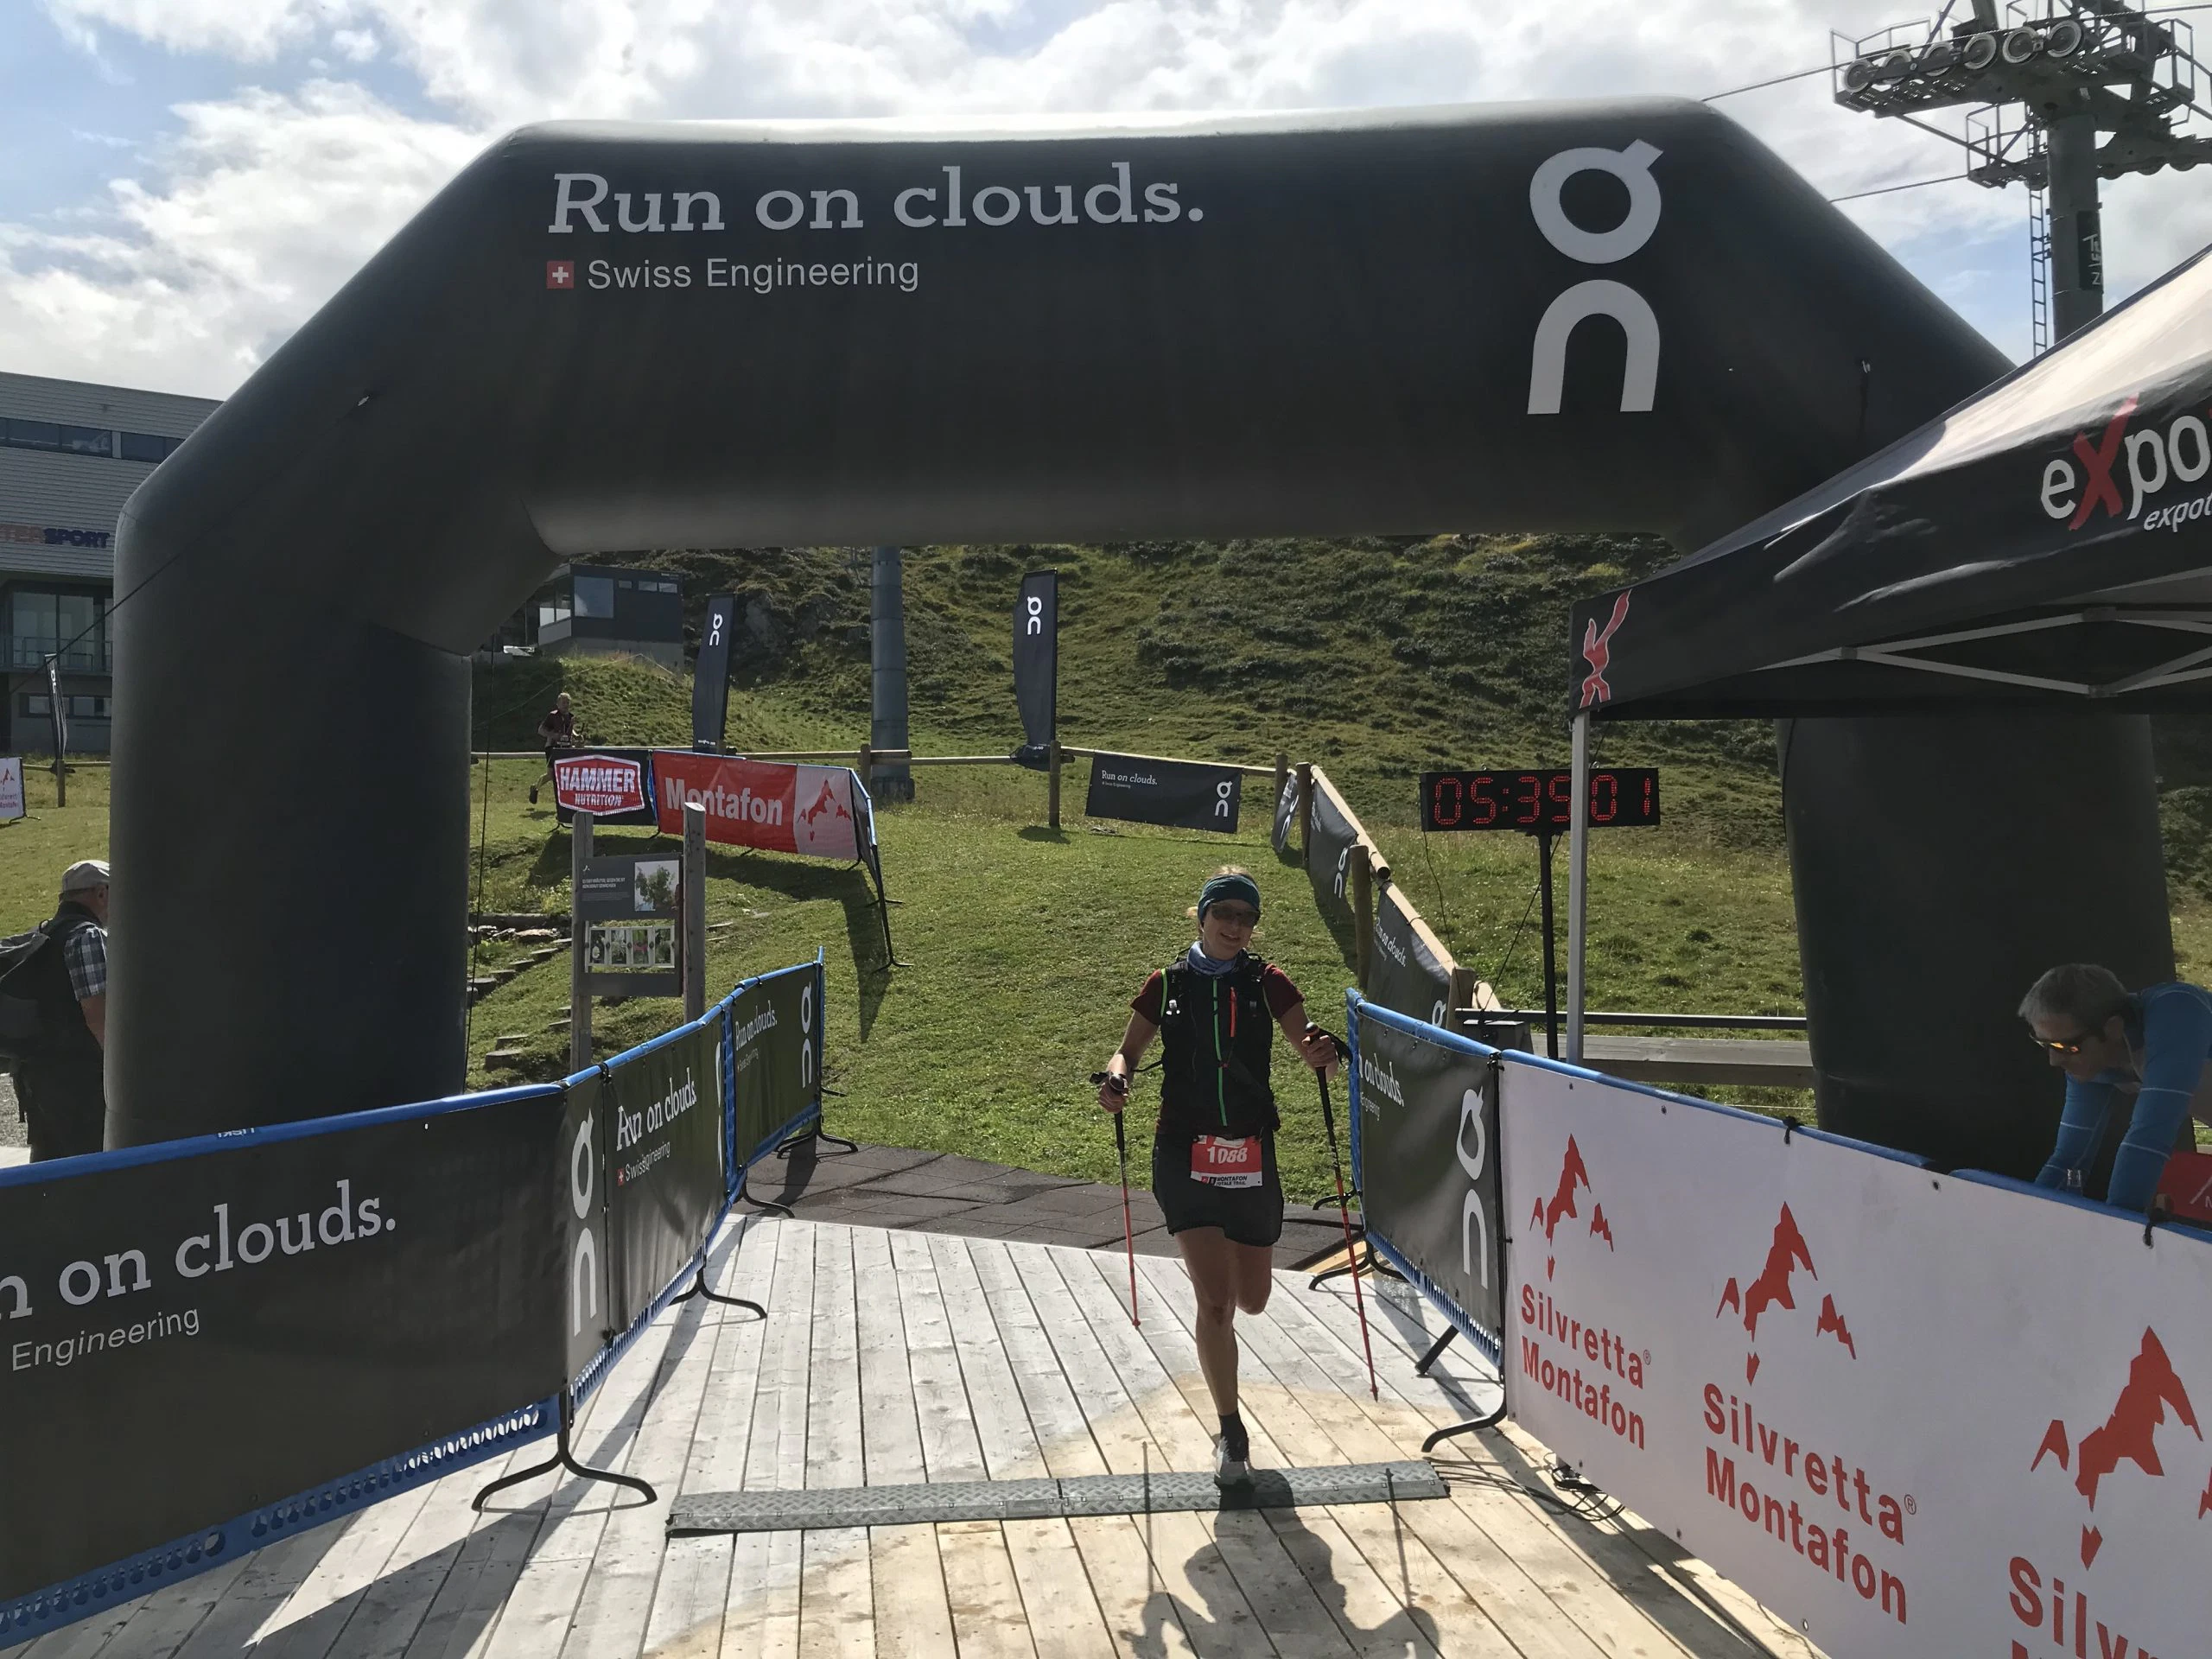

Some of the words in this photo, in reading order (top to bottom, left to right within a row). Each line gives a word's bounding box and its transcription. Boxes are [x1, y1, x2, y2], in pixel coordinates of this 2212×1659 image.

[548, 173, 725, 234] Run
[755, 188, 863, 231] on
[893, 162, 1205, 228] clouds.
[587, 259, 692, 289] Swiss
[707, 256, 919, 293] Engineering
[559, 766, 636, 793] HAMMER
[575, 792, 623, 806] NUTRITION
[664, 777, 784, 826] Montafon
[1102, 769, 1116, 780] Run
[1129, 772, 1158, 785] clouds.
[646, 1101, 664, 1134] on
[59, 1247, 152, 1306] on
[175, 1179, 397, 1279] clouds.
[11, 1306, 200, 1372] Engineering
[1521, 1335, 1645, 1451] Montafon
[1705, 1446, 1907, 1624] Montafon
[2008, 1556, 2158, 1659] Silv
